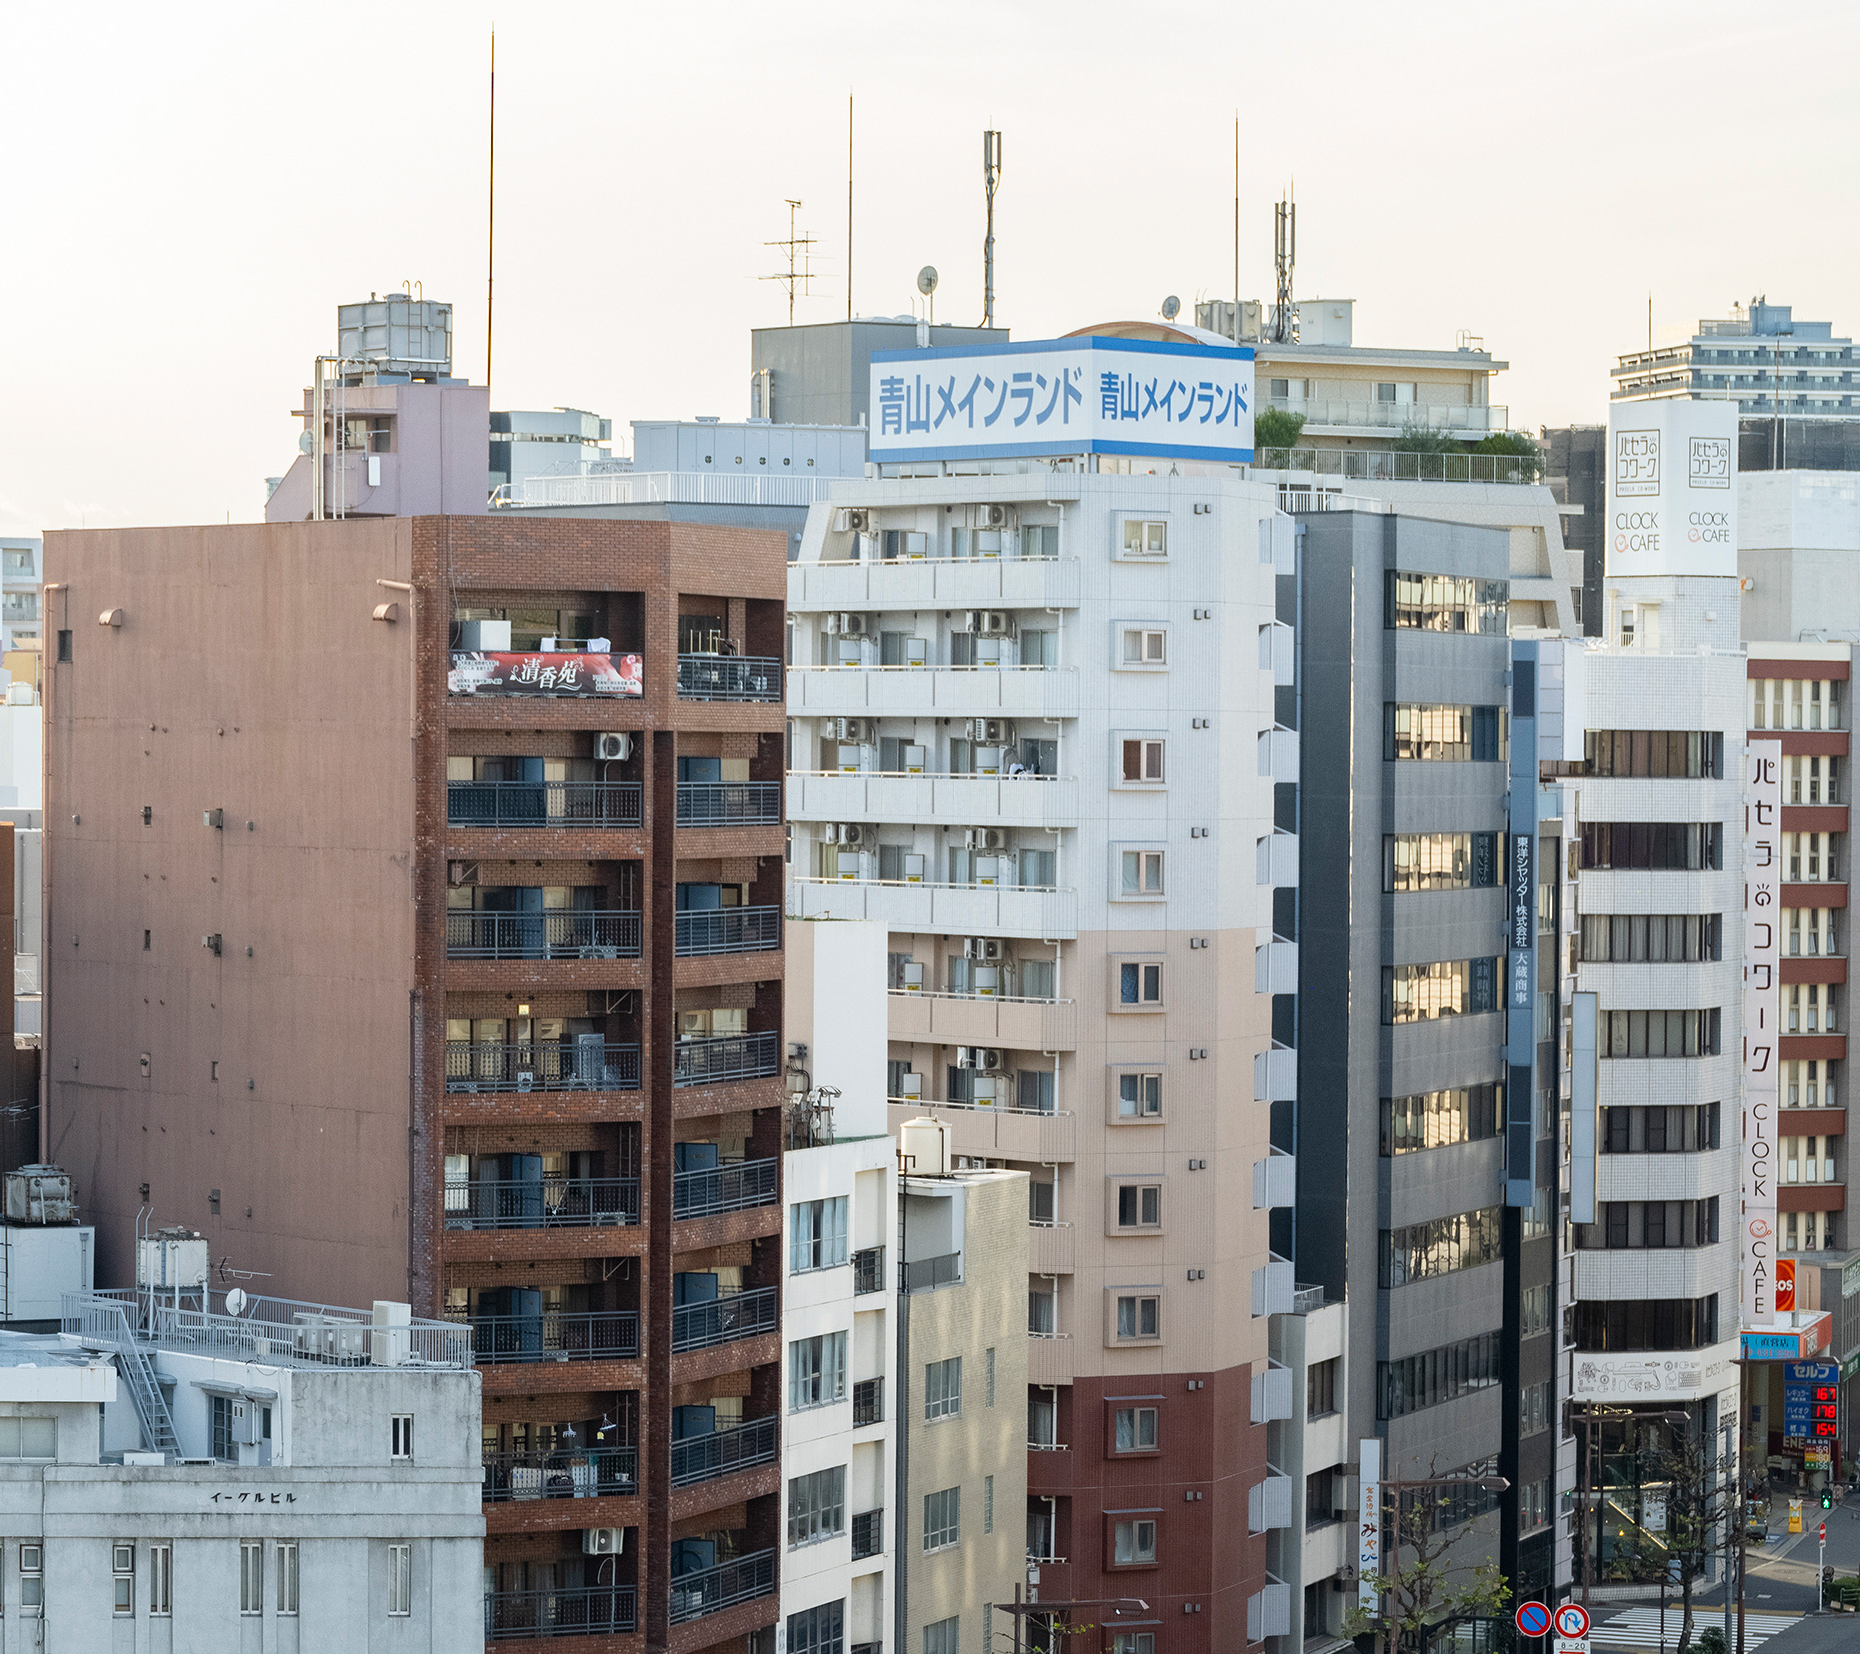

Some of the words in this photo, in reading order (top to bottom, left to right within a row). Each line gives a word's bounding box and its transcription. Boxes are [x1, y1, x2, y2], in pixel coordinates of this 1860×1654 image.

[879, 366, 1083, 436] 青山メインランド
[1100, 371, 1249, 428] 青山メインランド
[1619, 436, 1658, 457] パセラの
[1692, 442, 1728, 458] パセラの
[1619, 458, 1657, 479] コワーク
[1692, 459, 1727, 475] コワーク
[1616, 512, 1659, 530] CLOCK
[1688, 512, 1729, 526] CLOCK
[1629, 533, 1660, 551] CAFE
[1702, 528, 1730, 542] CAFE
[520, 656, 578, 690] 清香苑
[1752, 758, 1776, 1072] パセラのコワーク
[1515, 953, 1528, 1004] 大蔵商事
[1751, 1103, 1770, 1197] CLOCK
[1751, 1241, 1768, 1314] CAFE
[1793, 1364, 1830, 1379] セルフ
[1816, 1387, 1836, 1400] 167
[1787, 1407, 1809, 1416] ハイオク
[1816, 1405, 1836, 1418] 178
[1816, 1423, 1836, 1436] 154
[1360, 1522, 1378, 1562] みやび
[1561, 1641, 1586, 1650] 8-20
